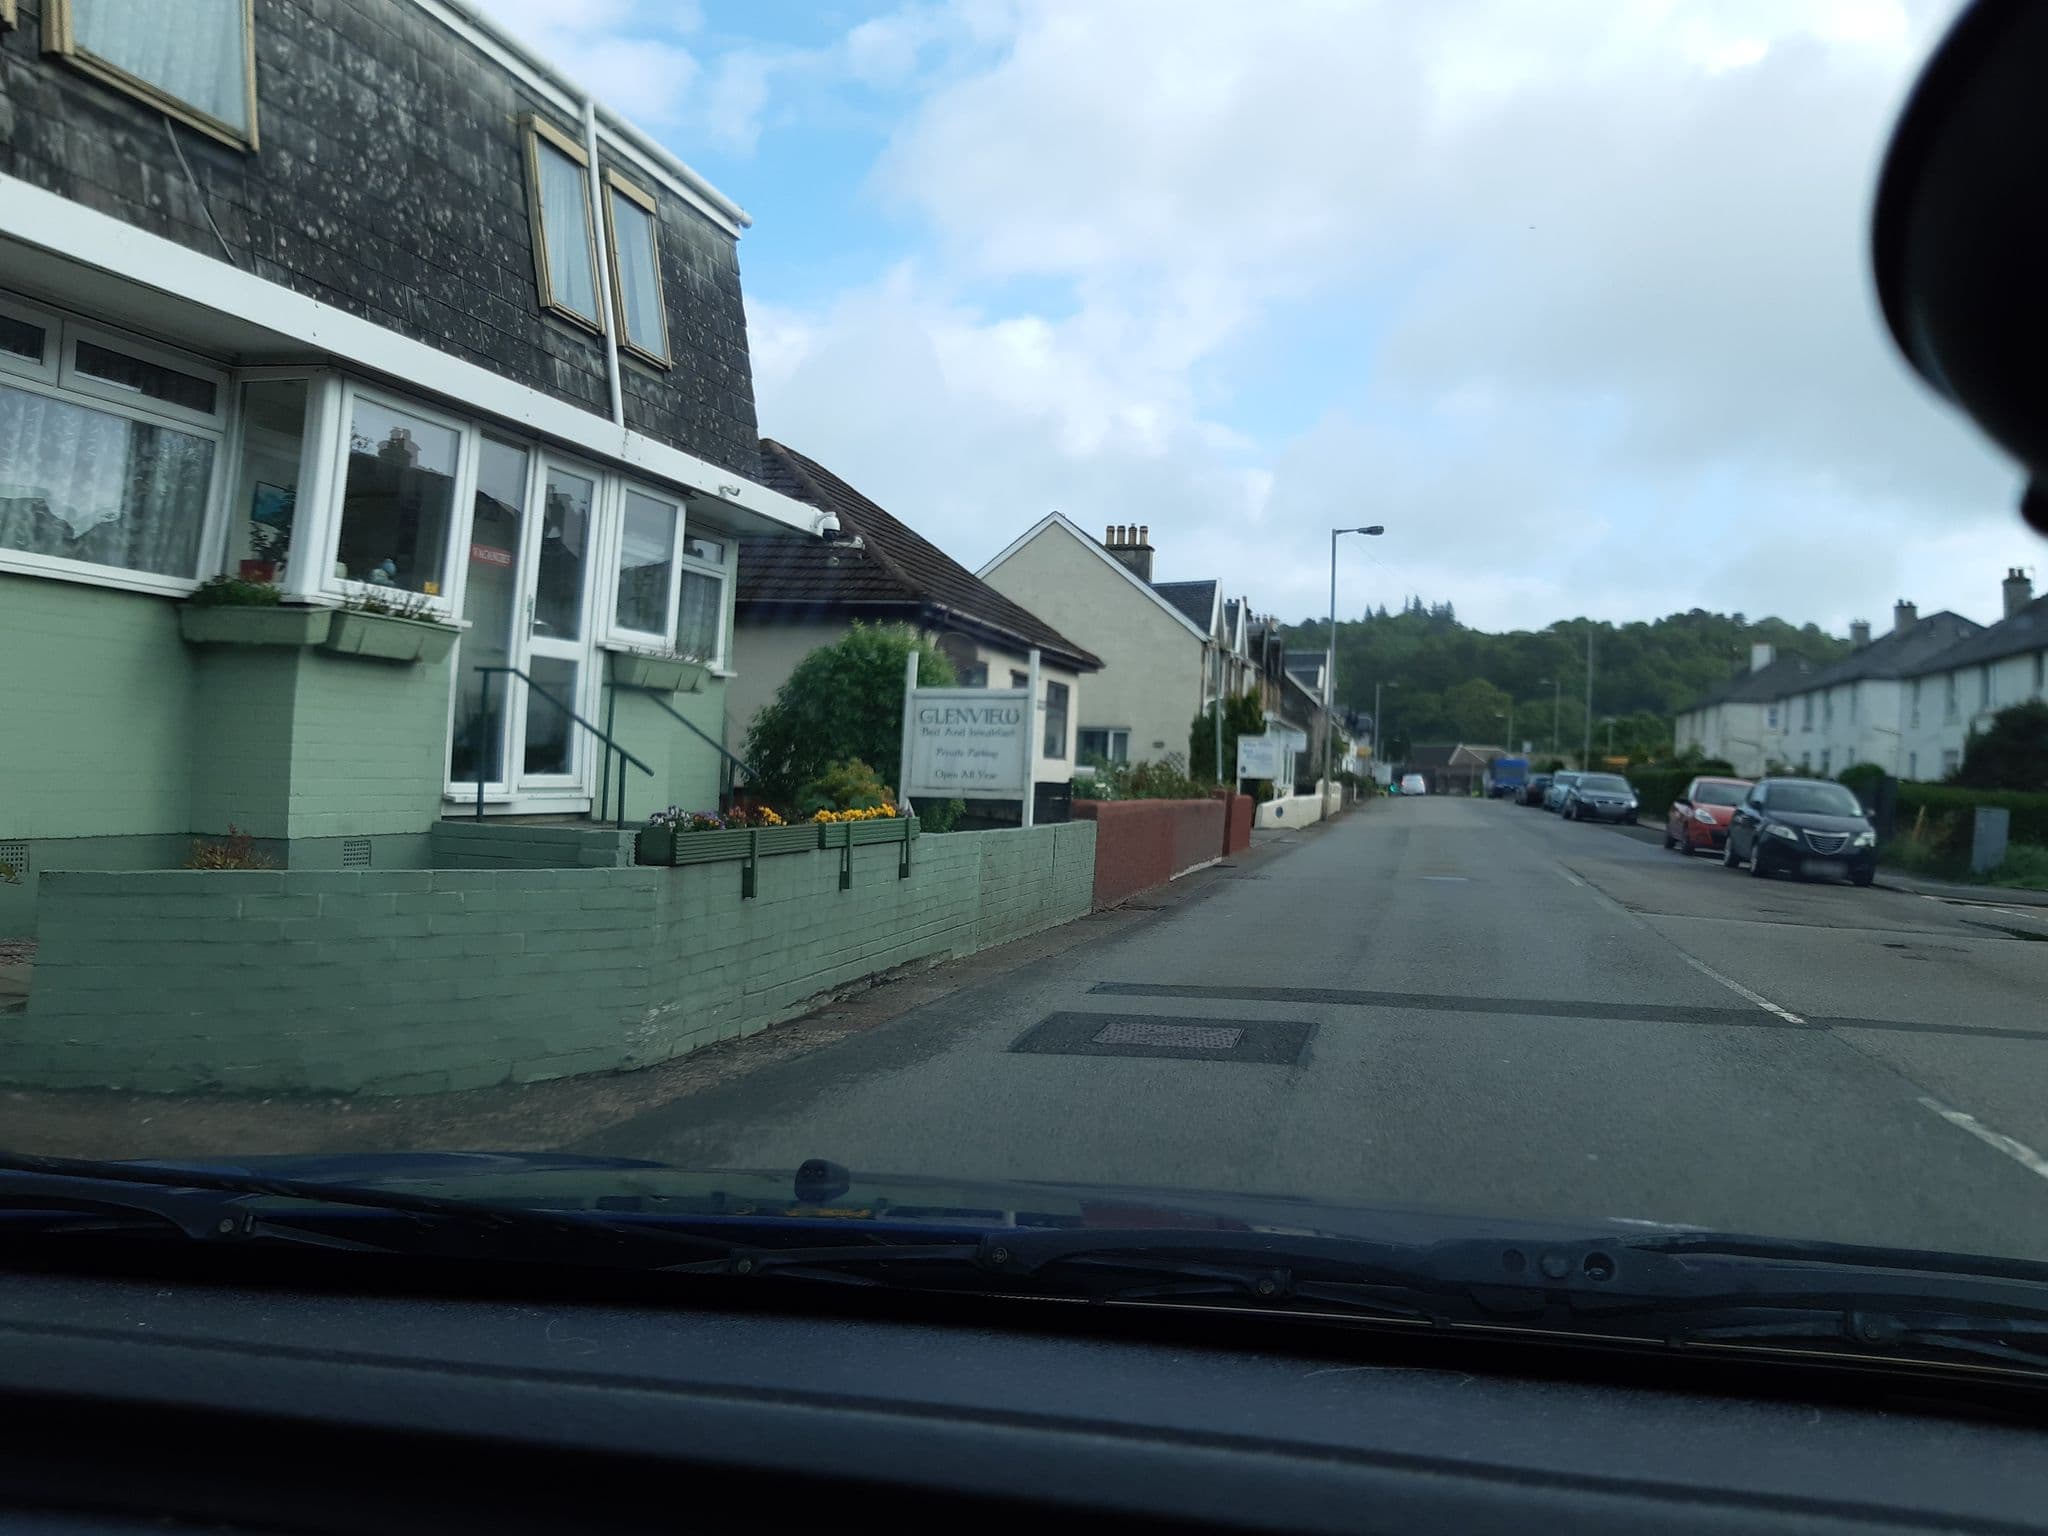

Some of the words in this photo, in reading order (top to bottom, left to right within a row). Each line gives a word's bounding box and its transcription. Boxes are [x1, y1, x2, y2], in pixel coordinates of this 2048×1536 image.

[920, 708, 1019, 725] GLENVIEW
[922, 728, 940, 737] Bed
[945, 728, 966, 737] And
[936, 748, 963, 758] Private
[968, 748, 999, 760] Parking
[935, 770, 958, 781] Open
[961, 770, 975, 779] All
[978, 770, 998, 780] Year
